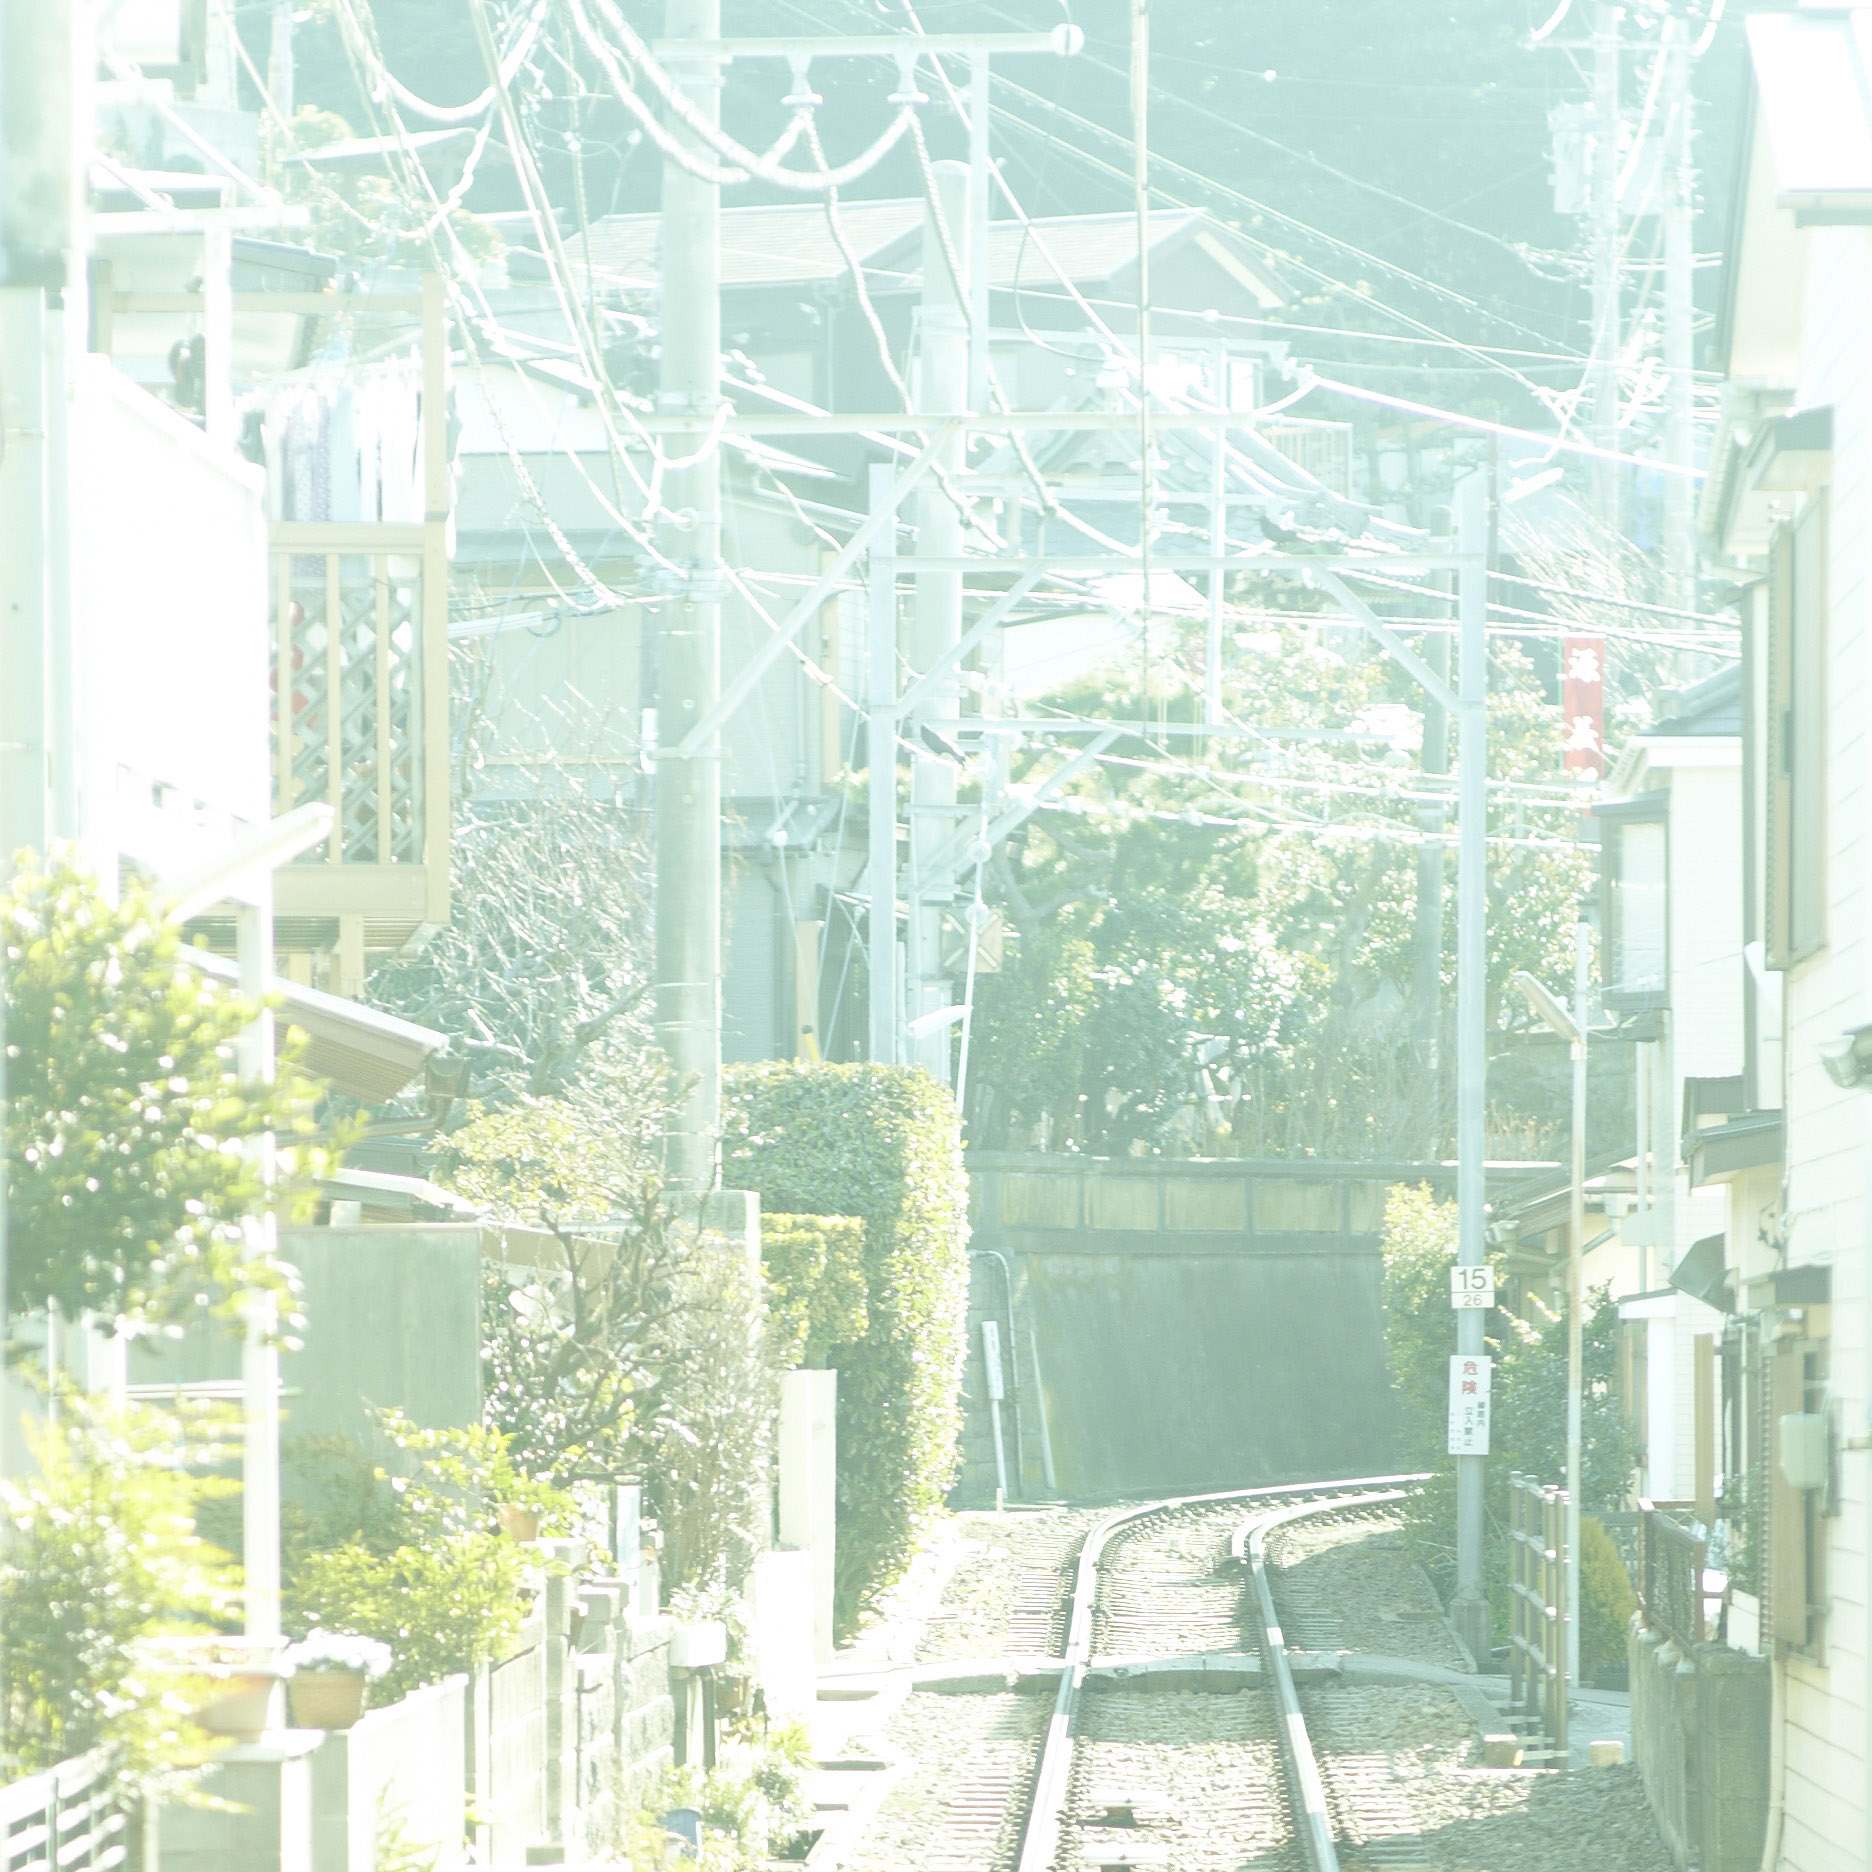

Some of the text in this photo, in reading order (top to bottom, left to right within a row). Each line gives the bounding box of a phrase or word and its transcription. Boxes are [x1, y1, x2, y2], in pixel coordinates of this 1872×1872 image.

[1458, 1268, 1486, 1290] 15
[1463, 1294, 1482, 1307] 26
[1461, 1360, 1478, 1395] 危険
